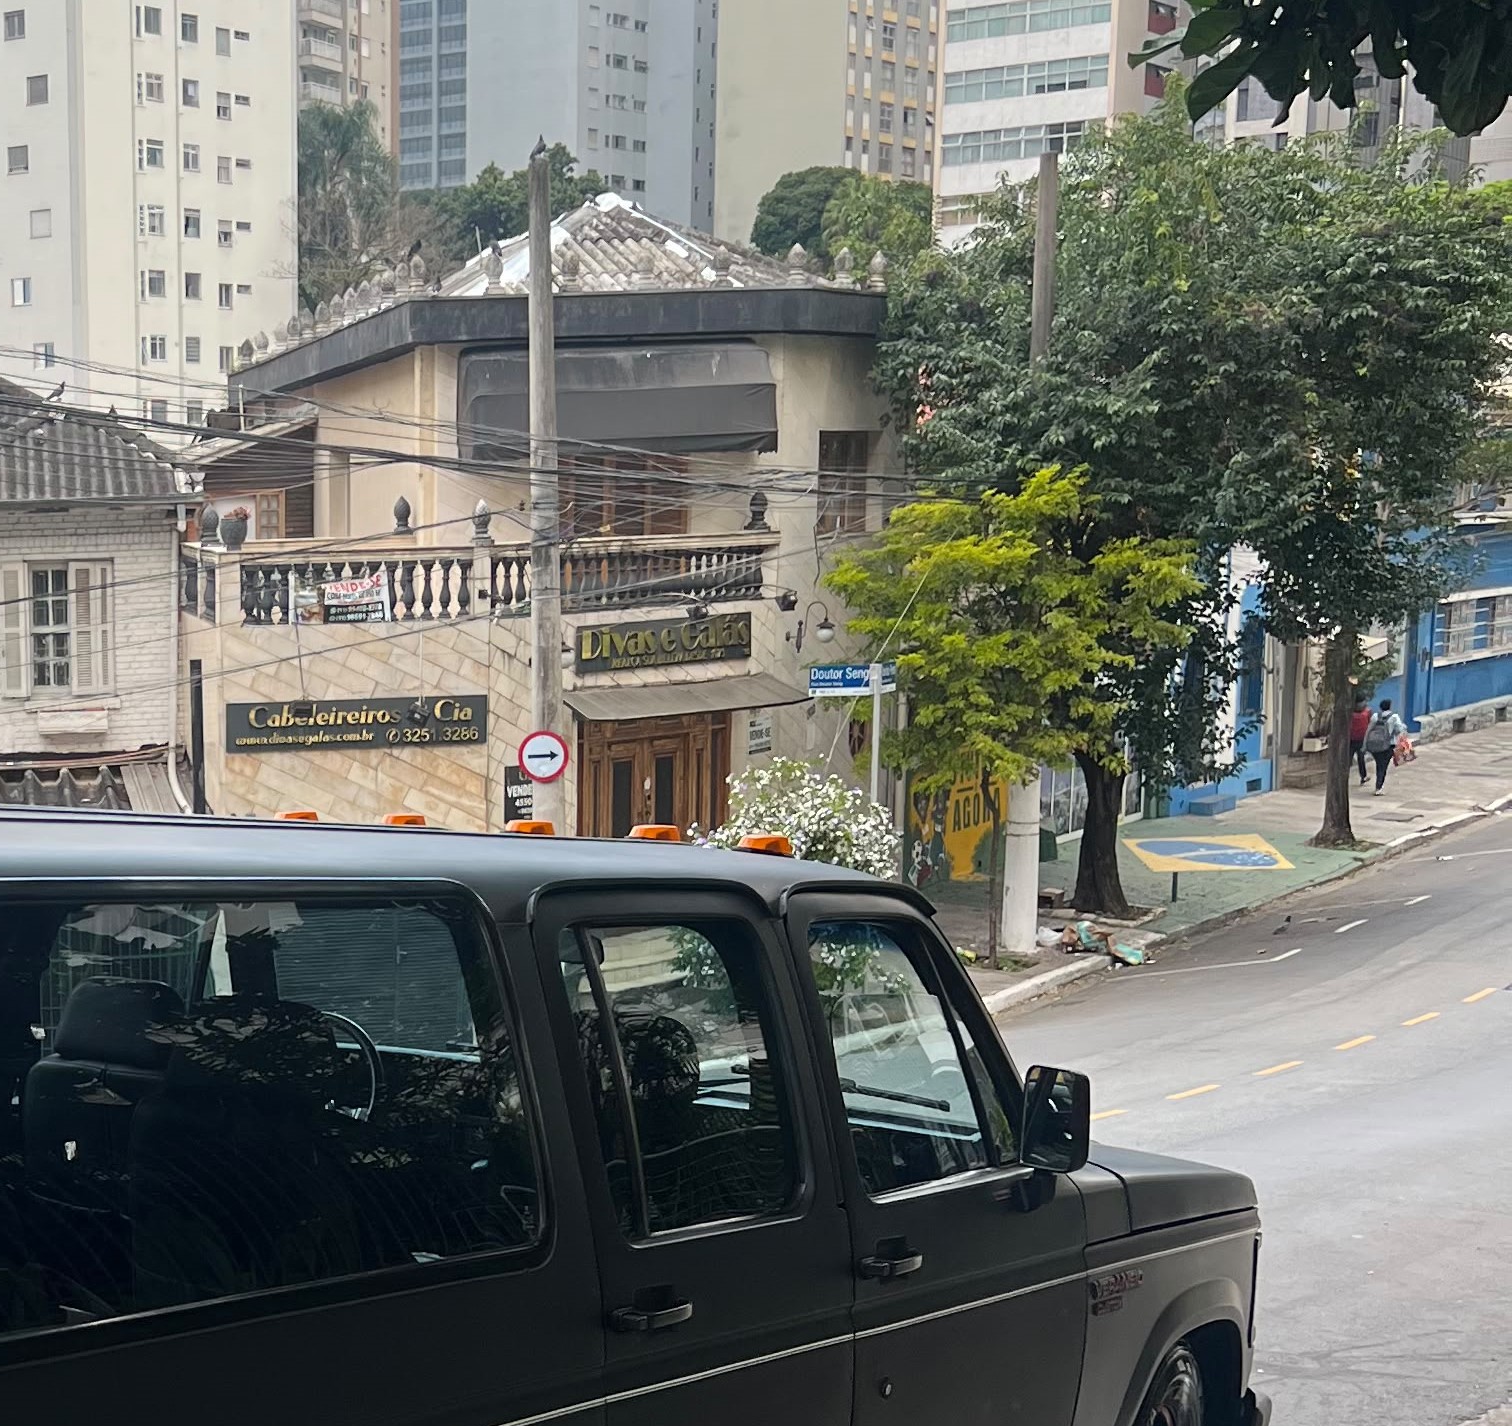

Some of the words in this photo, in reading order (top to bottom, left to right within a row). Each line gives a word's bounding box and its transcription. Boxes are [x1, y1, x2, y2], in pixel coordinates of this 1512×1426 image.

[581, 627, 657, 660] Divas
[660, 627, 677, 652] e
[810, 667, 844, 680] Doutor
[845, 667, 870, 681] Seng
[434, 699, 474, 722] Cia
[403, 727, 479, 743] 3251.3286
